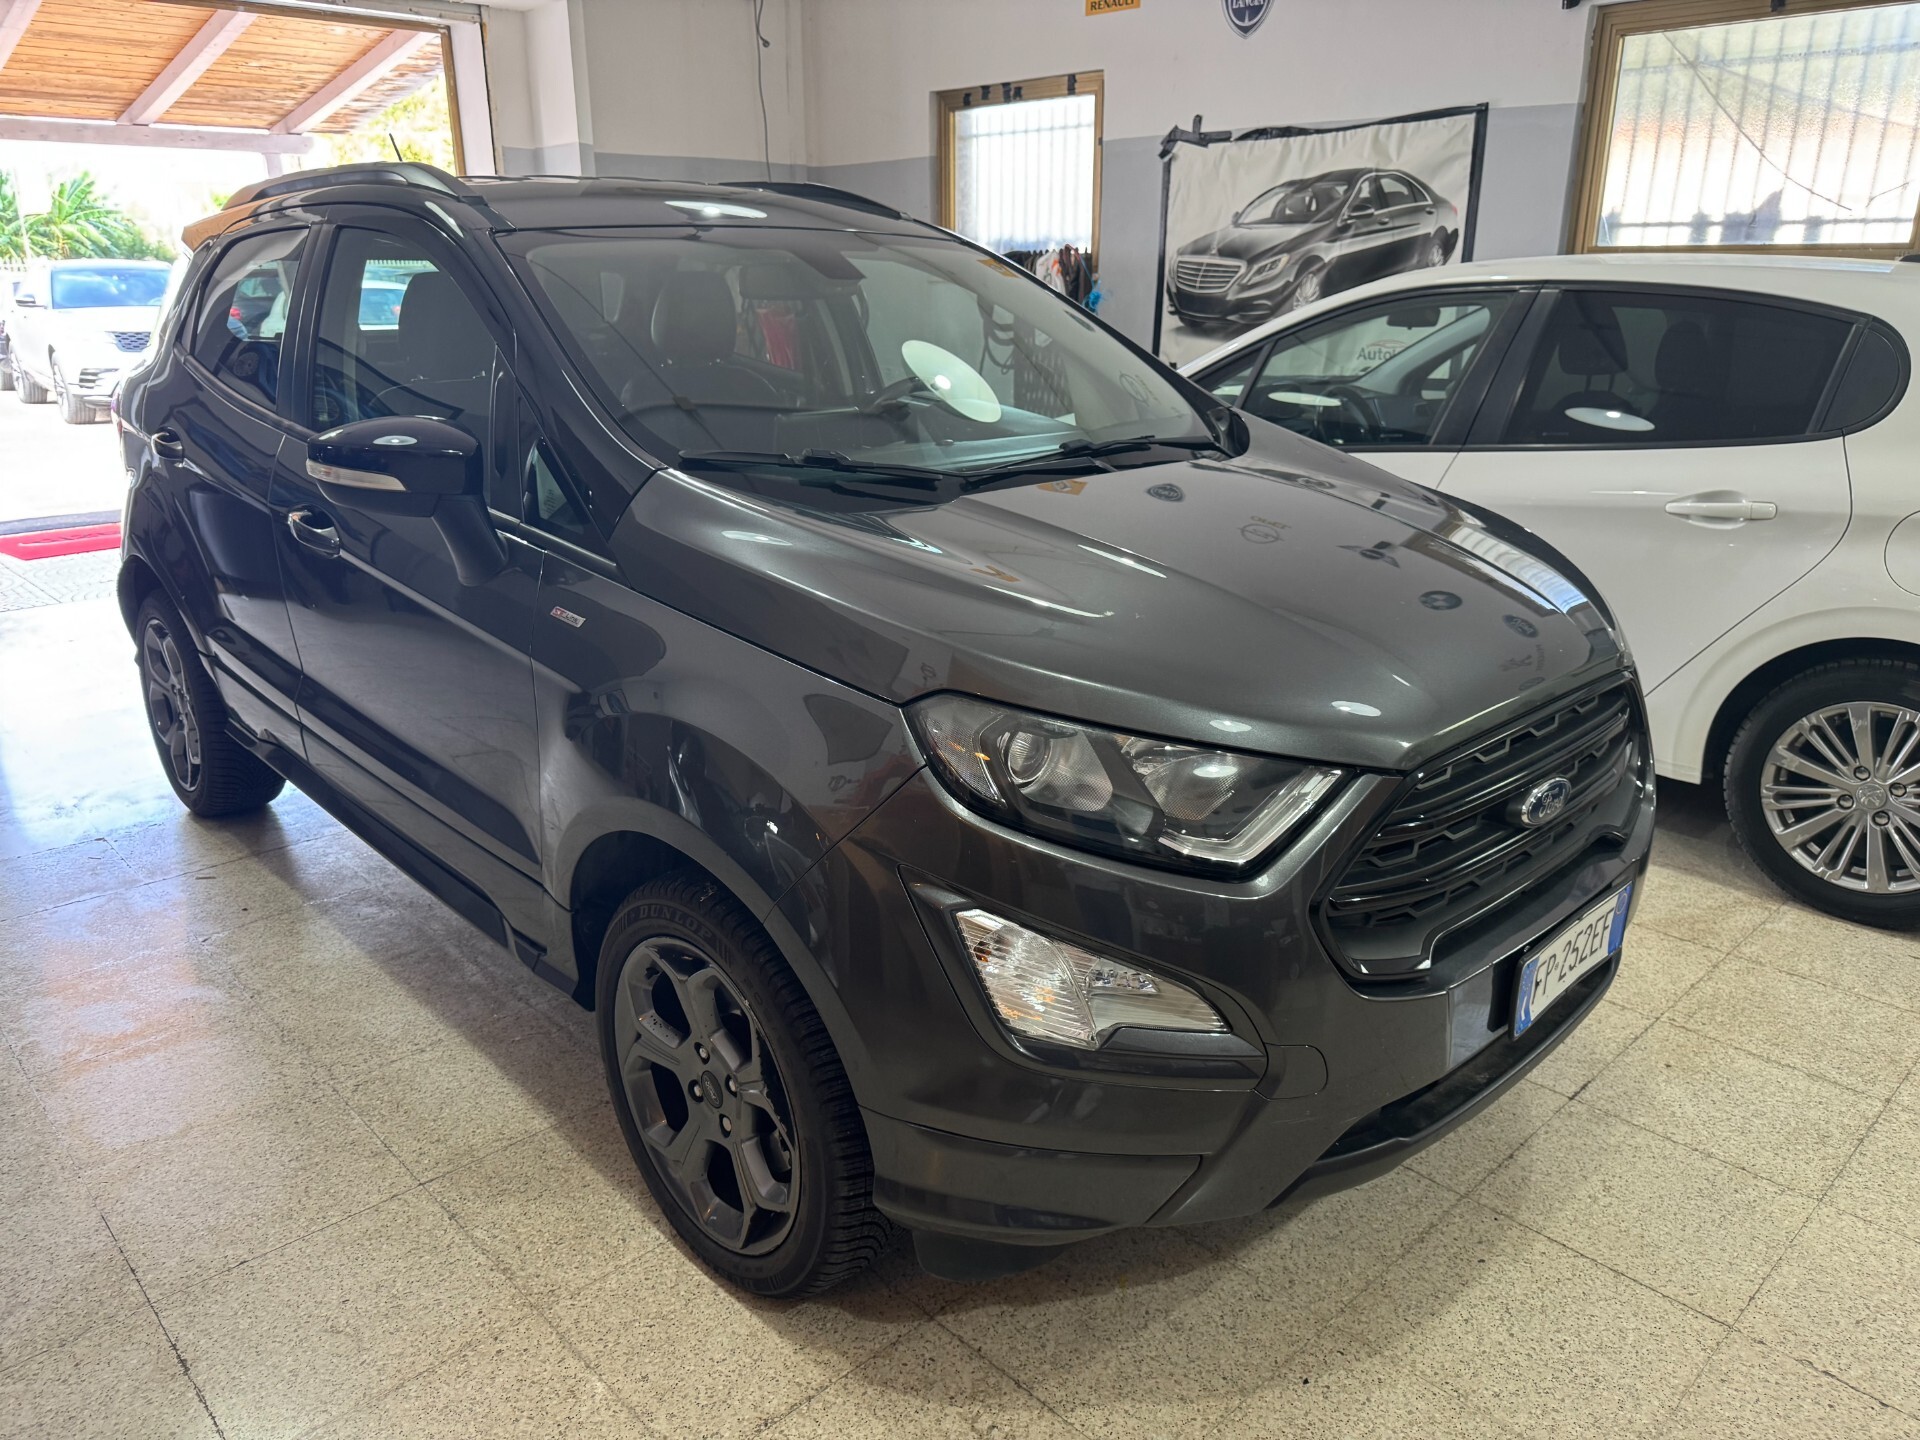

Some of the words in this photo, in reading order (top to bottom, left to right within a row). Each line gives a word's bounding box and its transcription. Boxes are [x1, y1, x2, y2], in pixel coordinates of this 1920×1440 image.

[640, 905, 713, 939] DUNLOP
[1531, 954, 1558, 1005] FP
[1558, 906, 1615, 983] 252EF
